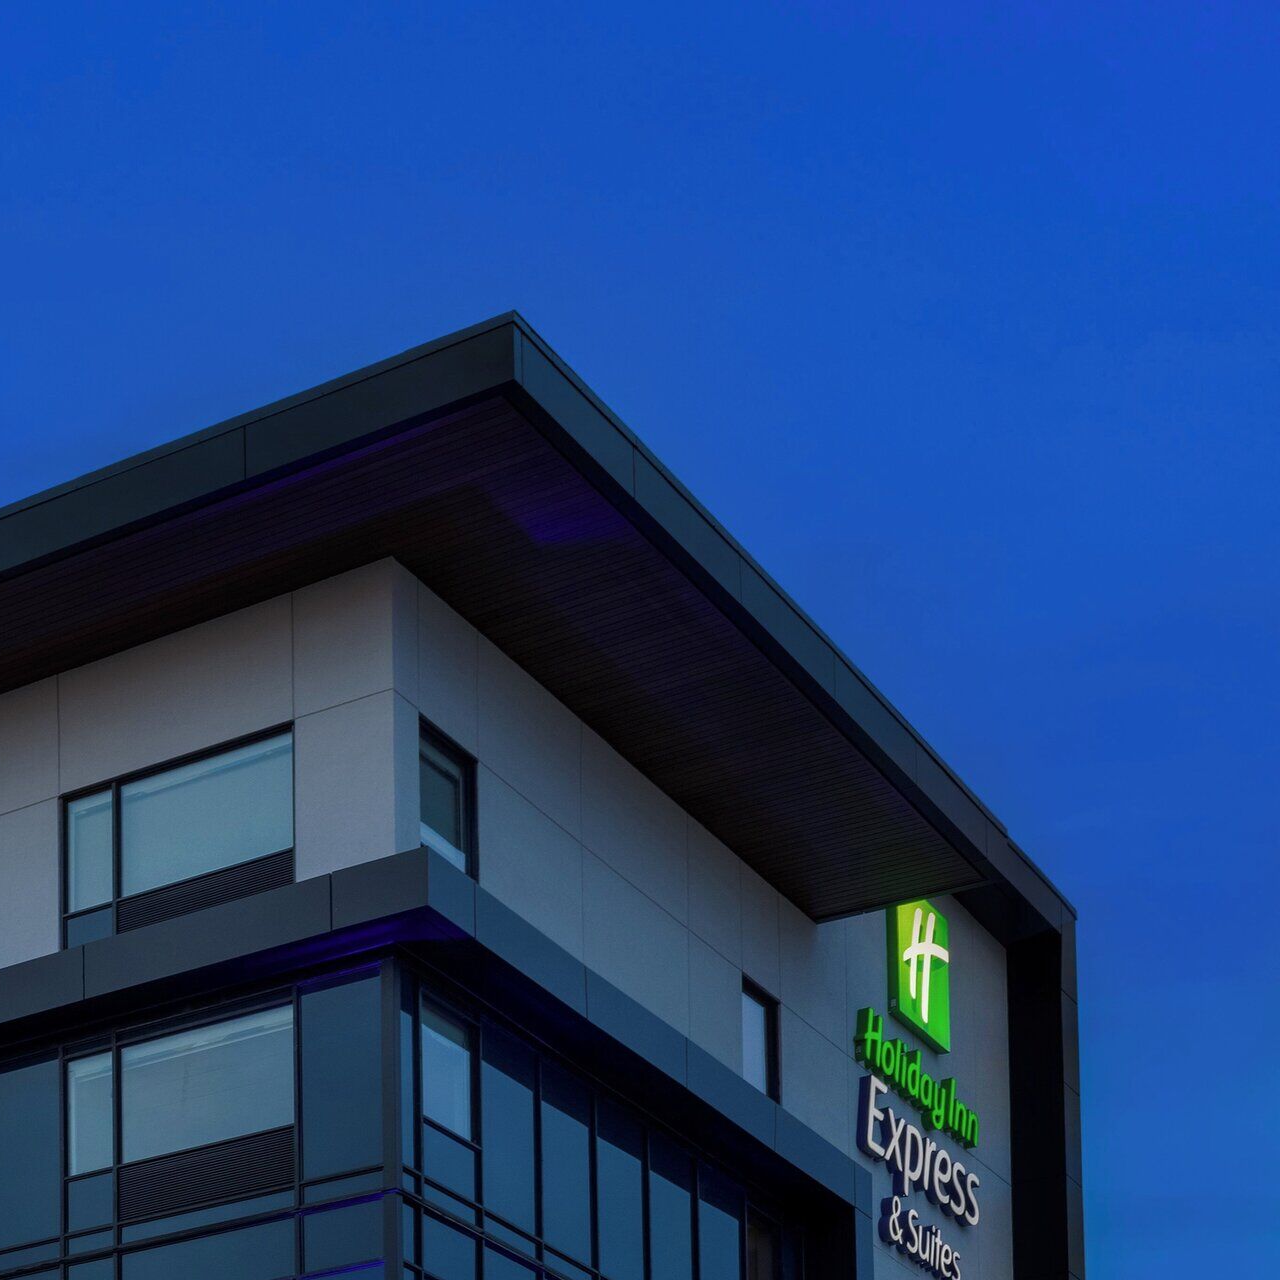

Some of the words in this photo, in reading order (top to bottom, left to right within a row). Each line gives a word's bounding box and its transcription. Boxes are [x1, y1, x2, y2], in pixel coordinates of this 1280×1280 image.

[863, 1007, 945, 1130] Holiday
[947, 1078, 979, 1148] Inn
[867, 1074, 980, 1226] Express
[889, 1195, 903, 1244] &
